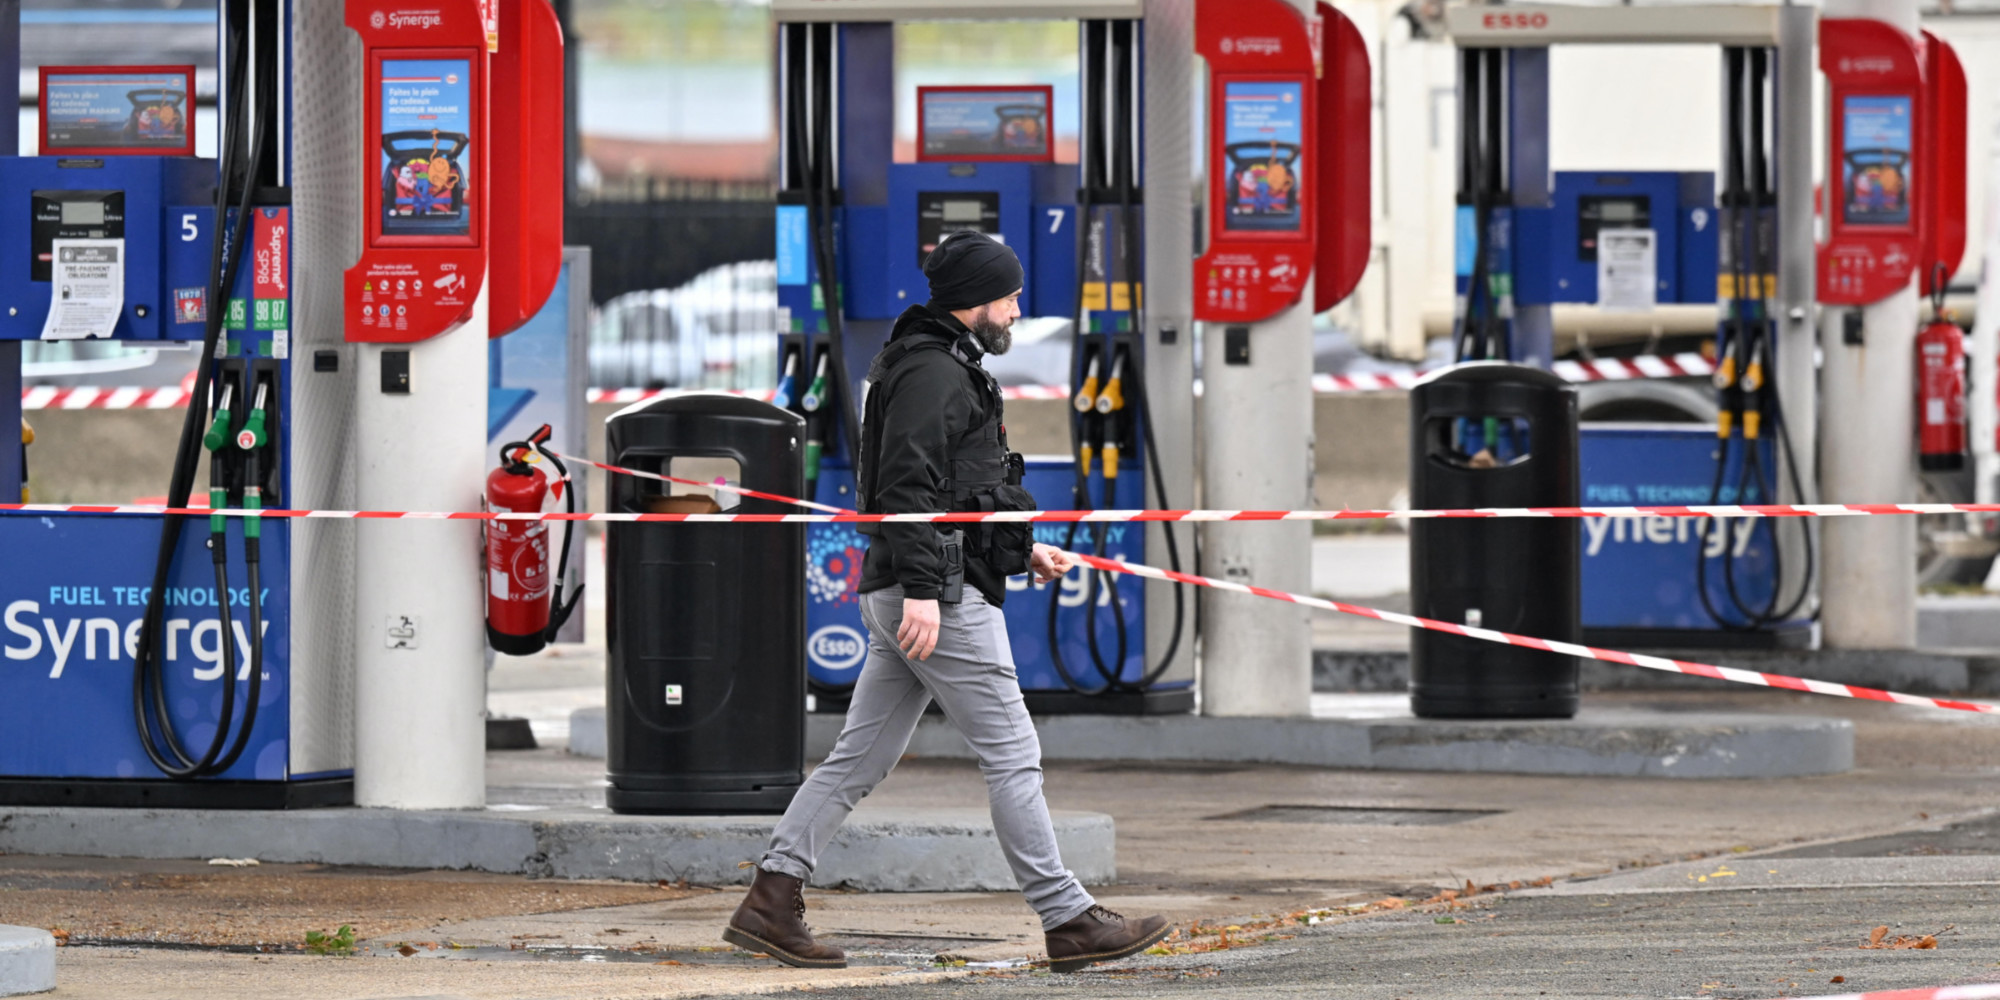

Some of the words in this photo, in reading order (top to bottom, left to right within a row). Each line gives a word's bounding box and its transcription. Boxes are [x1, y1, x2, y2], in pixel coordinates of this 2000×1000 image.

[389, 12, 441, 29] Synergie
[1483, 12, 1548, 29] ESSO
[181, 213, 199, 242] 5
[1047, 208, 1065, 234] 7
[1691, 208, 1708, 232] 9
[256, 249, 269, 284] SP98
[269, 225, 285, 291] Supreme+
[440, 263, 457, 271] CCTV
[230, 300, 245, 321] 85
[255, 300, 269, 321] 98
[272, 300, 286, 321] 87
[1586, 485, 1631, 502] FUEL
[1637, 485, 1759, 502] TECHNOOY
[1582, 516, 1758, 559] ynergy
[50, 586, 106, 605] FUEL
[4, 600, 269, 681] Synergy
[817, 635, 858, 656] Esso
